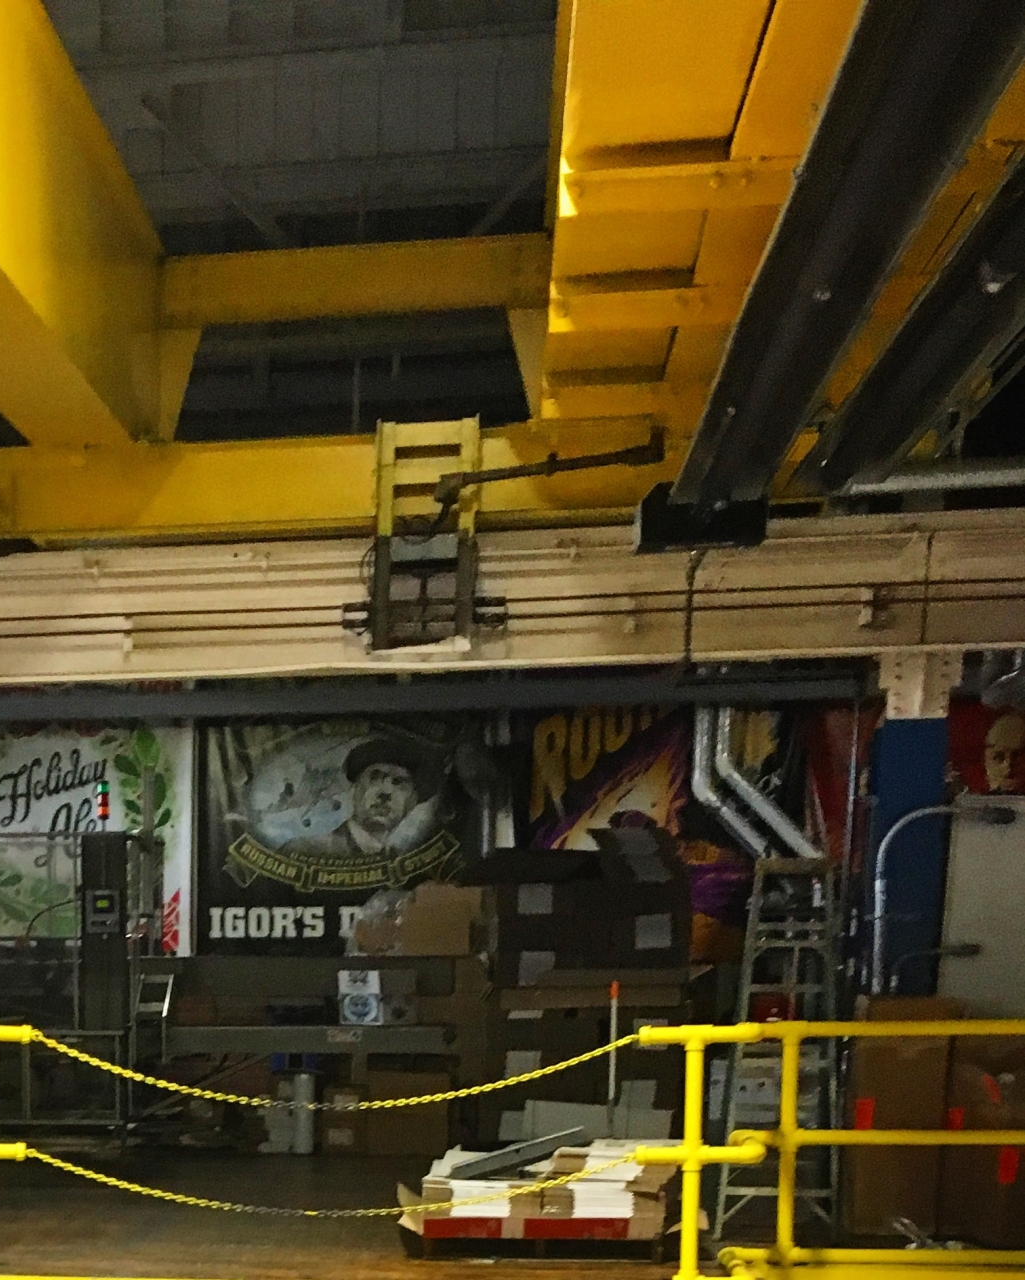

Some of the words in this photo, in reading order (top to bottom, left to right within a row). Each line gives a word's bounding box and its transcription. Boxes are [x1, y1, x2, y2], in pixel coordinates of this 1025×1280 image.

[239, 843, 298, 879] RUSSIAN
[317, 867, 384, 885] IMPERIAL
[208, 905, 325, 939] IGOR'S
